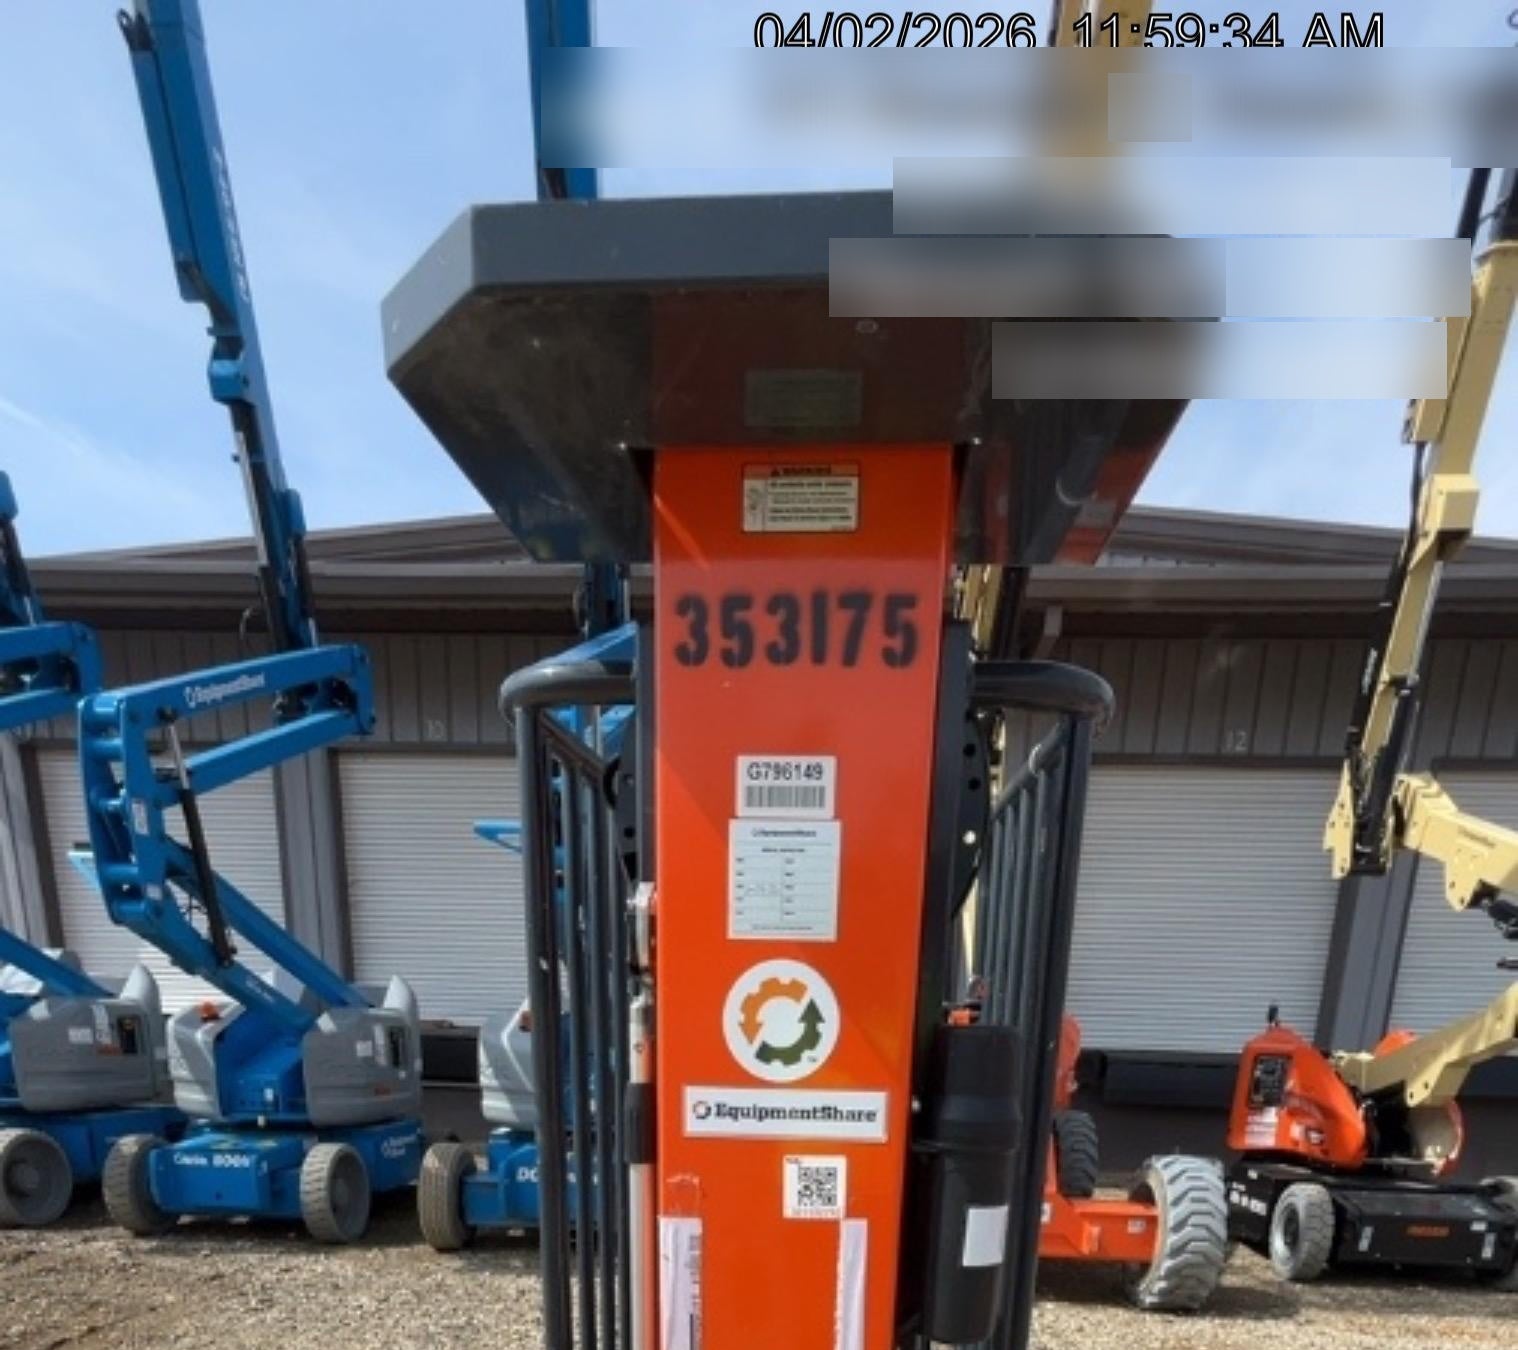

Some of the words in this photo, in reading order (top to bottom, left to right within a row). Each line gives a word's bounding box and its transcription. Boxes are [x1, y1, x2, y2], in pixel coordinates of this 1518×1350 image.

[674, 589, 918, 668] 353175
[747, 762, 823, 781] G796149
[714, 1102, 878, 1123] EquipmentShare
